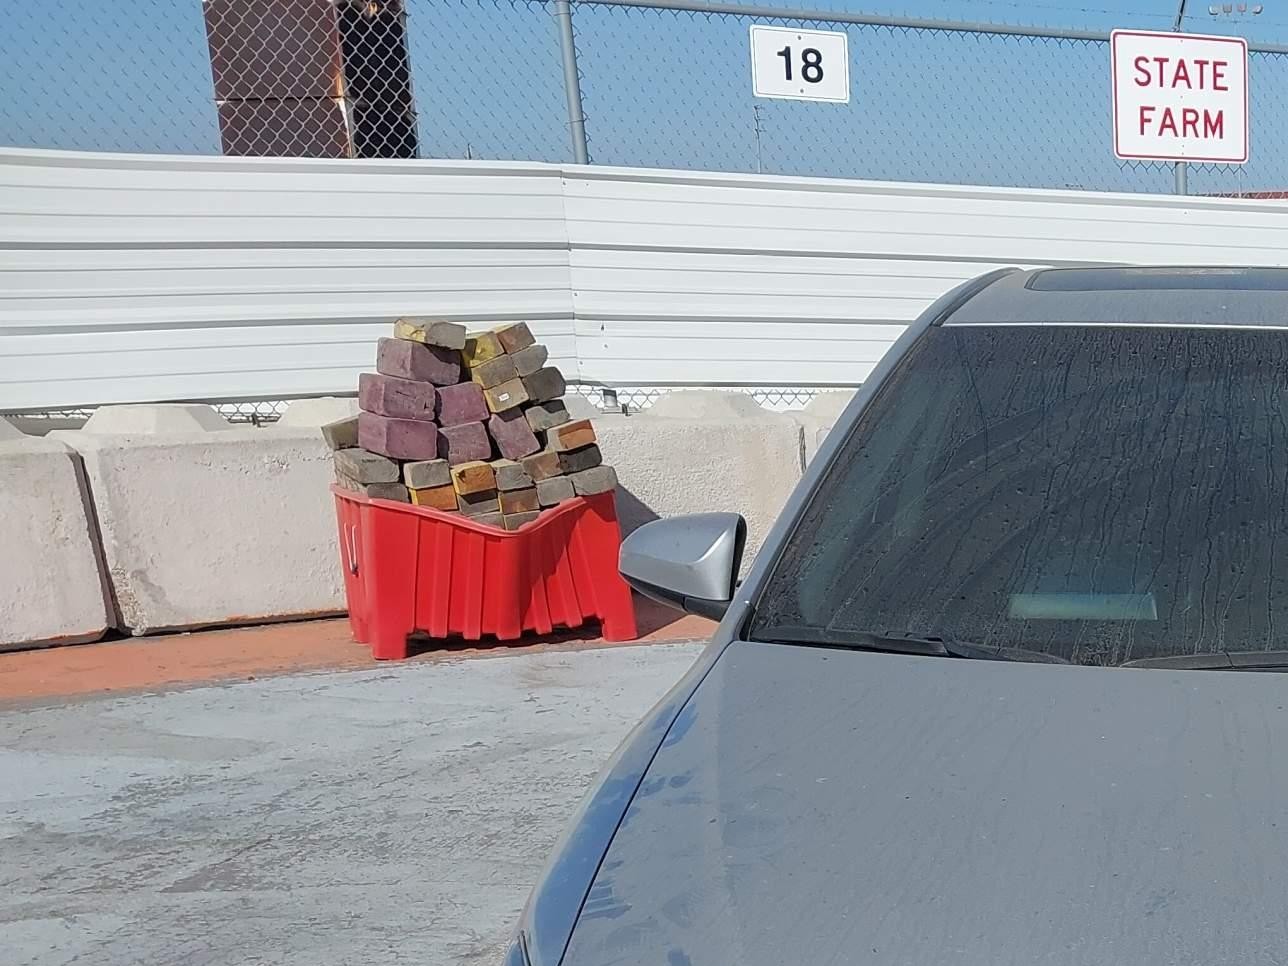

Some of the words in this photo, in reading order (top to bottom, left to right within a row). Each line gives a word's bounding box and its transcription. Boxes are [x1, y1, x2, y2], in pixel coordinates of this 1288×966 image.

[777, 46, 824, 84] 18
[1132, 55, 1230, 92] STATE
[1138, 105, 1225, 141] FARM
